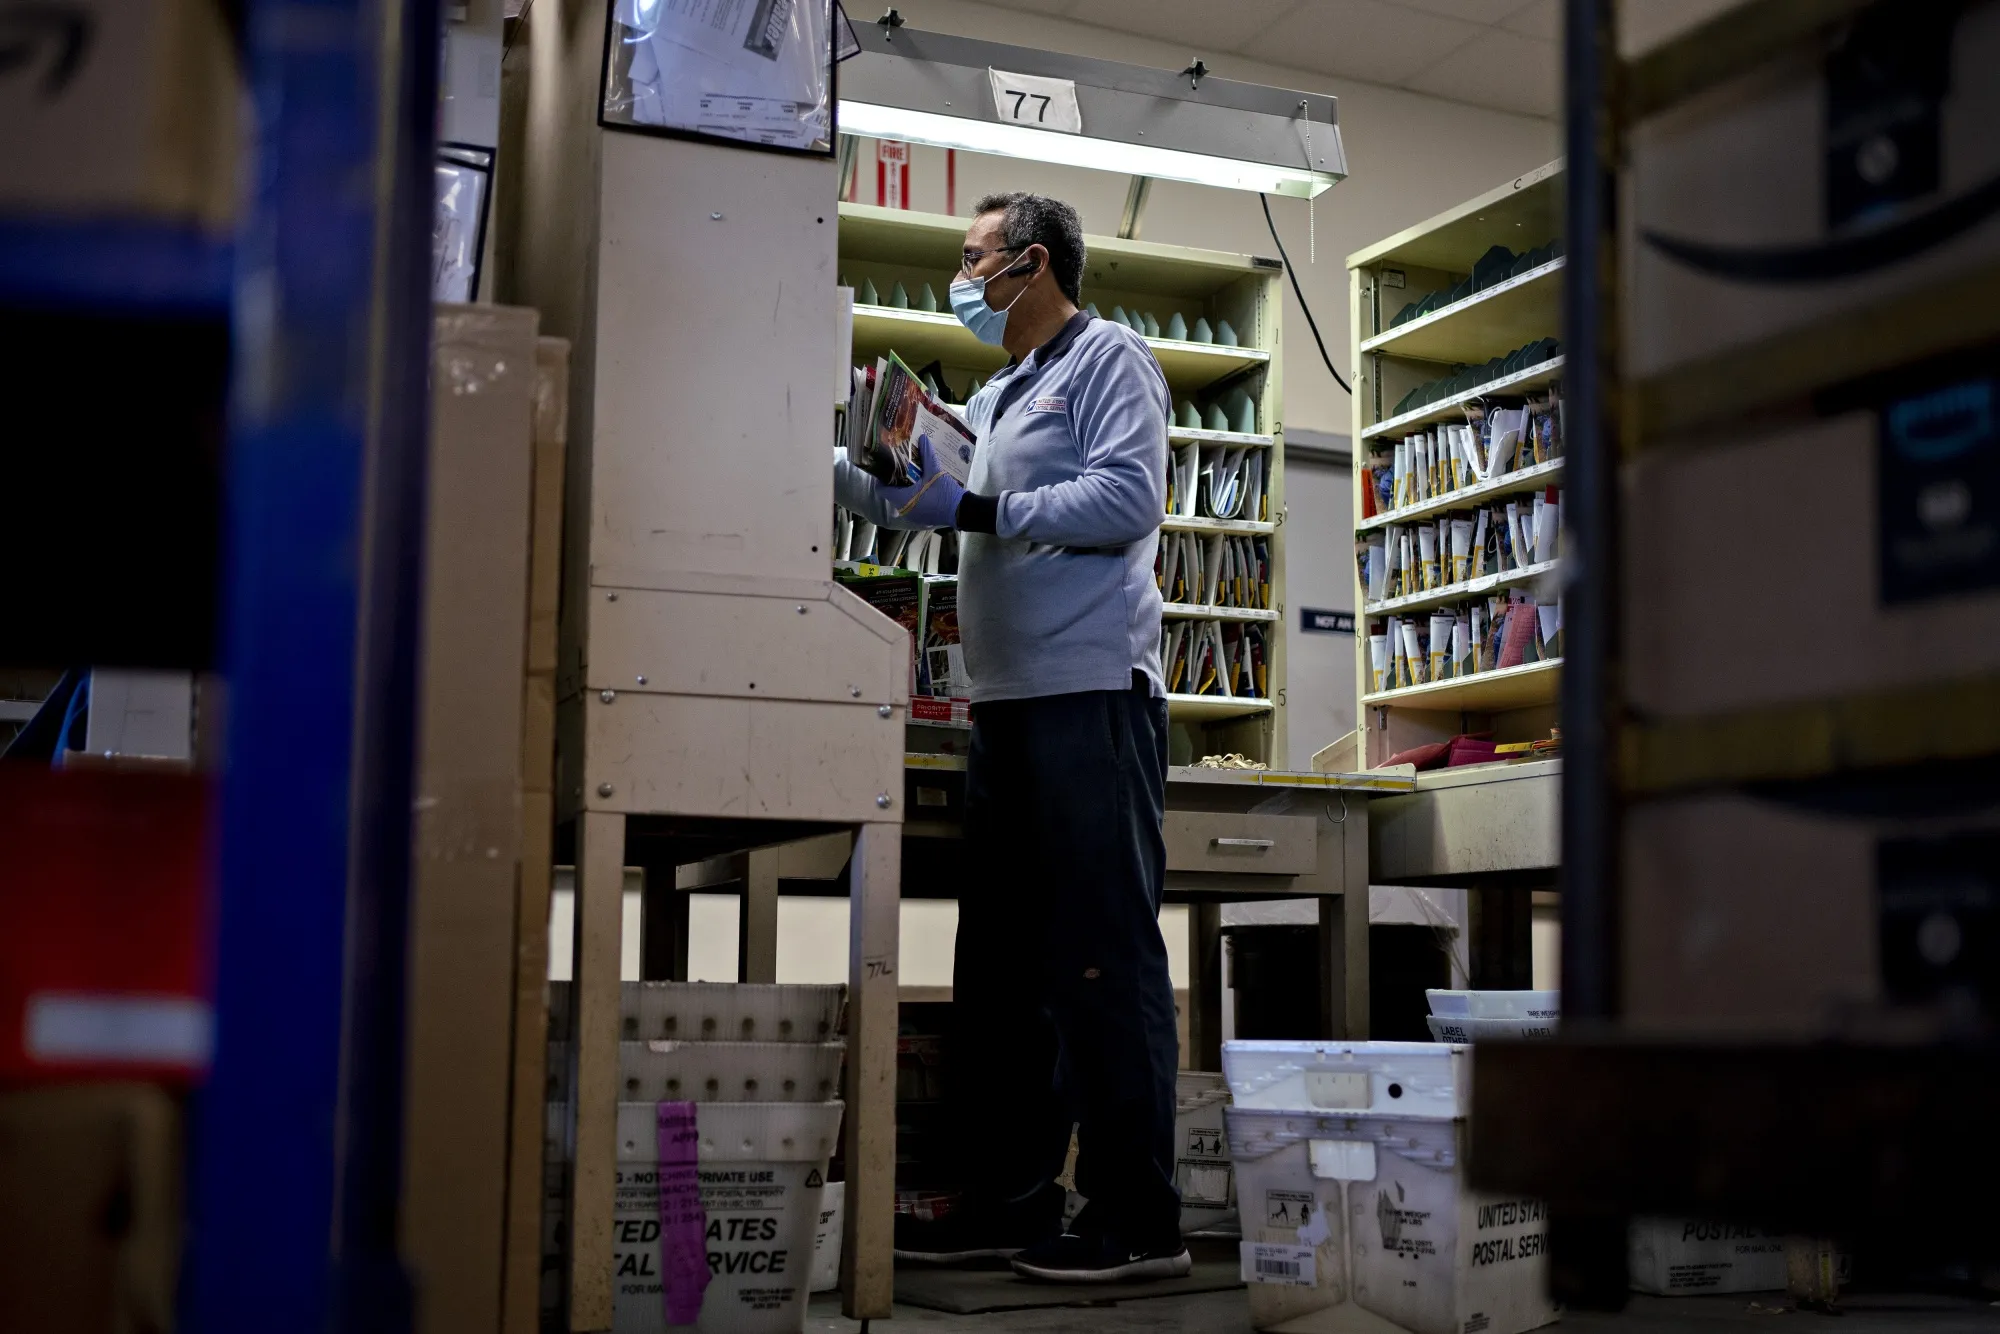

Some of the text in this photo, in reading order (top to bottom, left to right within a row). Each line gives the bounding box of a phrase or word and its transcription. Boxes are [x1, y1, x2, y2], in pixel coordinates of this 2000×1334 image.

[1005, 89, 1051, 122] 77
[881, 144, 904, 160] FIRE
[1273, 421, 1283, 435] 2
[1275, 512, 1283, 527] 3
[1276, 602, 1284, 620] 4
[1278, 688, 1286, 707] 5
[916, 704, 946, 712] PRIORITY
[1440, 1026, 1467, 1037] LABEL
[697, 1171, 745, 1183] PRIVATE
[749, 1171, 774, 1183] USE
[1404, 1210, 1431, 1219] WEIGHT
[1478, 1202, 1517, 1230] UNITED
[706, 1218, 778, 1242] ATES
[1683, 1221, 1757, 1242] POSTAL
[1472, 1238, 1516, 1268] POSTAL
[1735, 1243, 1783, 1253] FOR MAIL ONL
[705, 1250, 788, 1275] RVICE
[621, 1284, 646, 1295] FOR
